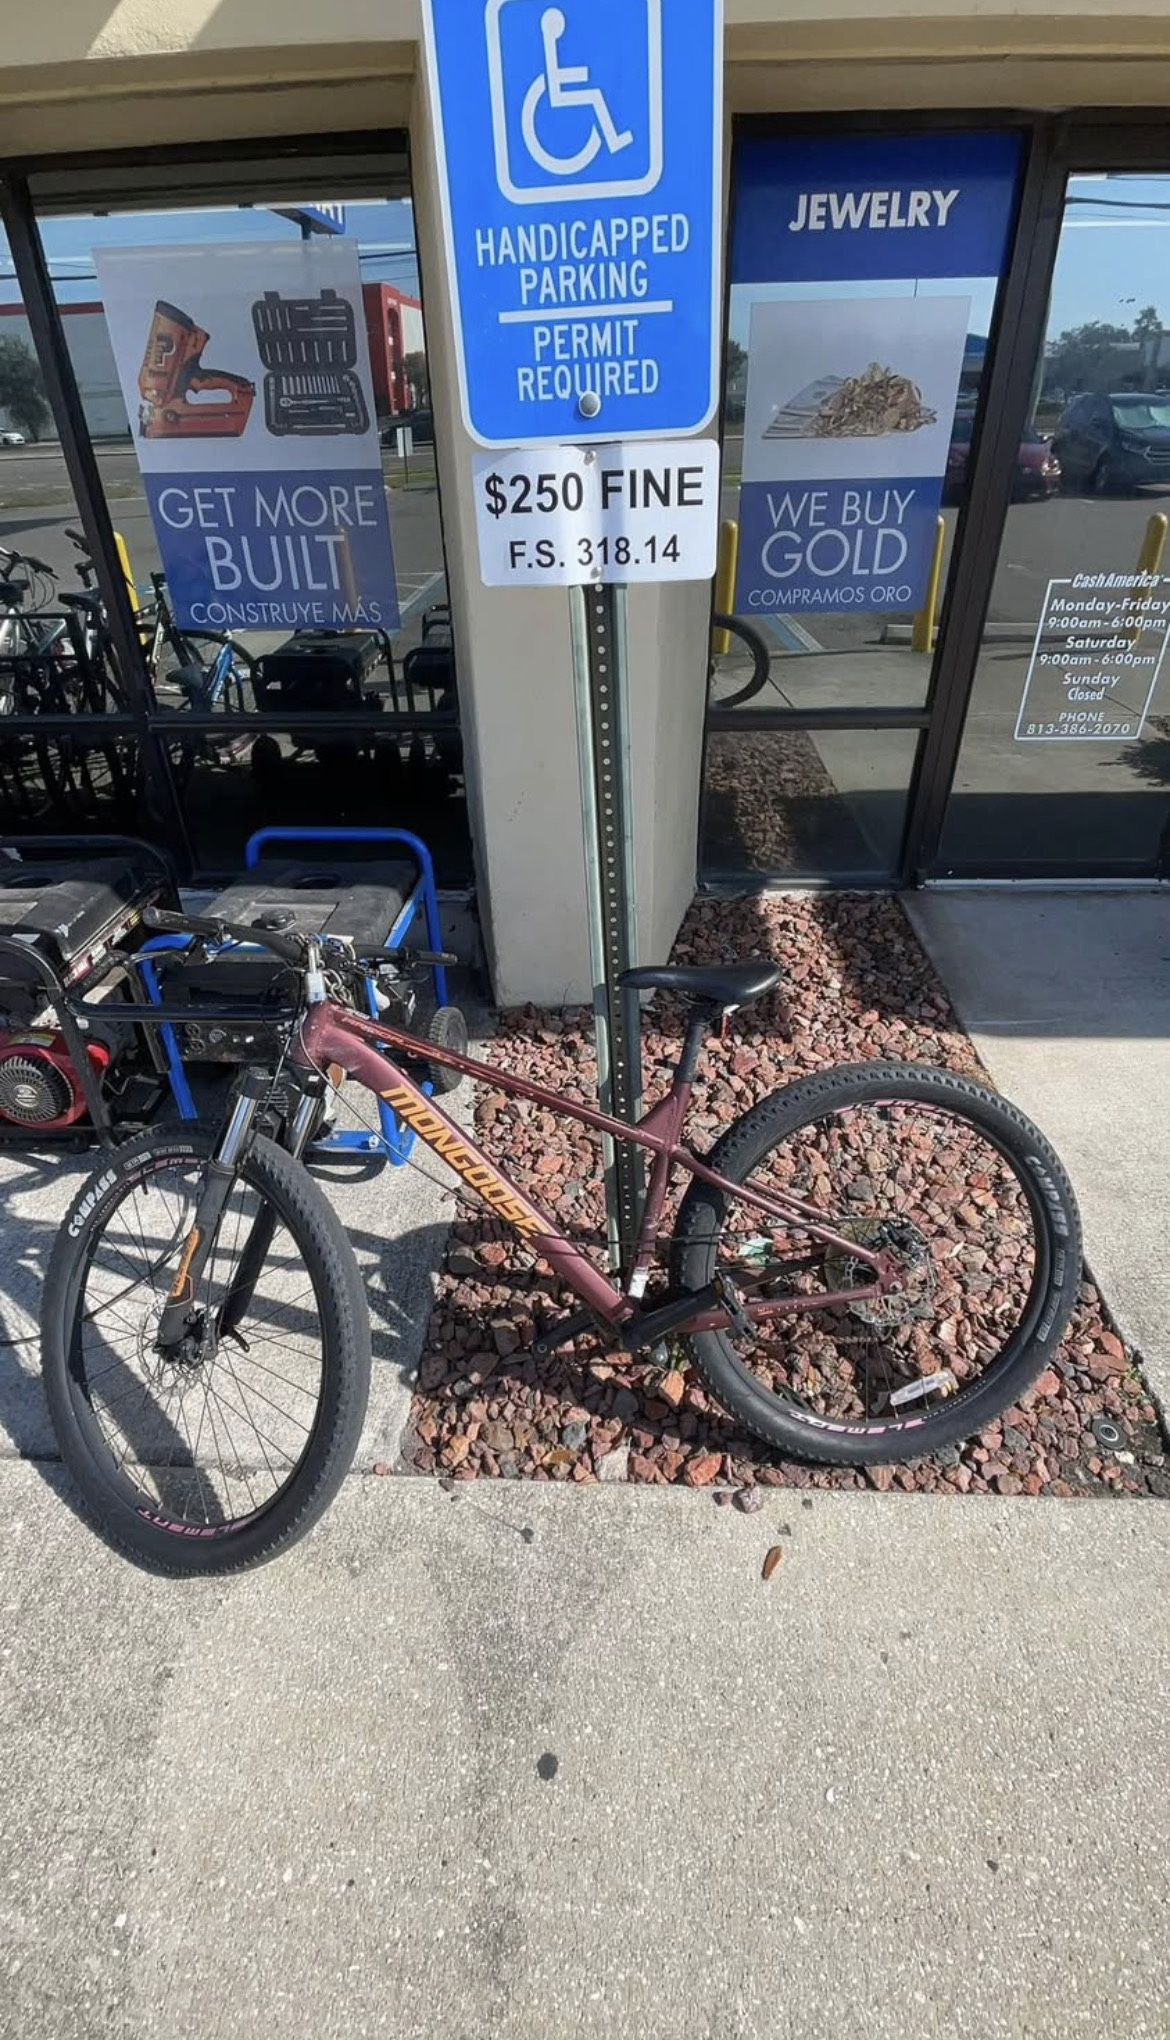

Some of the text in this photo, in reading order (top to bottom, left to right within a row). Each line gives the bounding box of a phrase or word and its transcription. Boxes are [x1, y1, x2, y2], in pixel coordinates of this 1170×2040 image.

[788, 188, 960, 232] JEWELRY
[475, 212, 690, 268] HANDICAPPED
[519, 259, 649, 306] PARKING
[533, 319, 639, 362] PERMIT
[517, 359, 660, 402] REQUIRED
[157, 485, 379, 529] GET MORE
[484, 466, 704, 519] $250 FINE
[766, 488, 916, 530] WE BUY
[204, 534, 346, 592] BUILT
[508, 534, 681, 569] F.S. 318.14
[760, 528, 909, 579] GOLD
[189, 595, 383, 625] CONSTRUYE MÁS
[747, 585, 912, 608] COMPRAMOS ORO
[1050, 597, 1170, 615] Monday-Friday
[1048, 615, 1101, 629] 9:00am
[1111, 615, 1166, 630] 6:00pm
[1065, 635, 1136, 651] Saturday
[1039, 653, 1092, 666] 9:00am
[1101, 653, 1156, 668] 6:00pm
[1062, 672, 1120, 688] Sunday
[1067, 687, 1105, 701] Closed
[1026, 723, 1130, 735] 813-386-2070
[1058, 712, 1104, 723] PHONE
[380, 1085, 552, 1239] MONGOOSE
[68, 1169, 117, 1238] COMPASS
